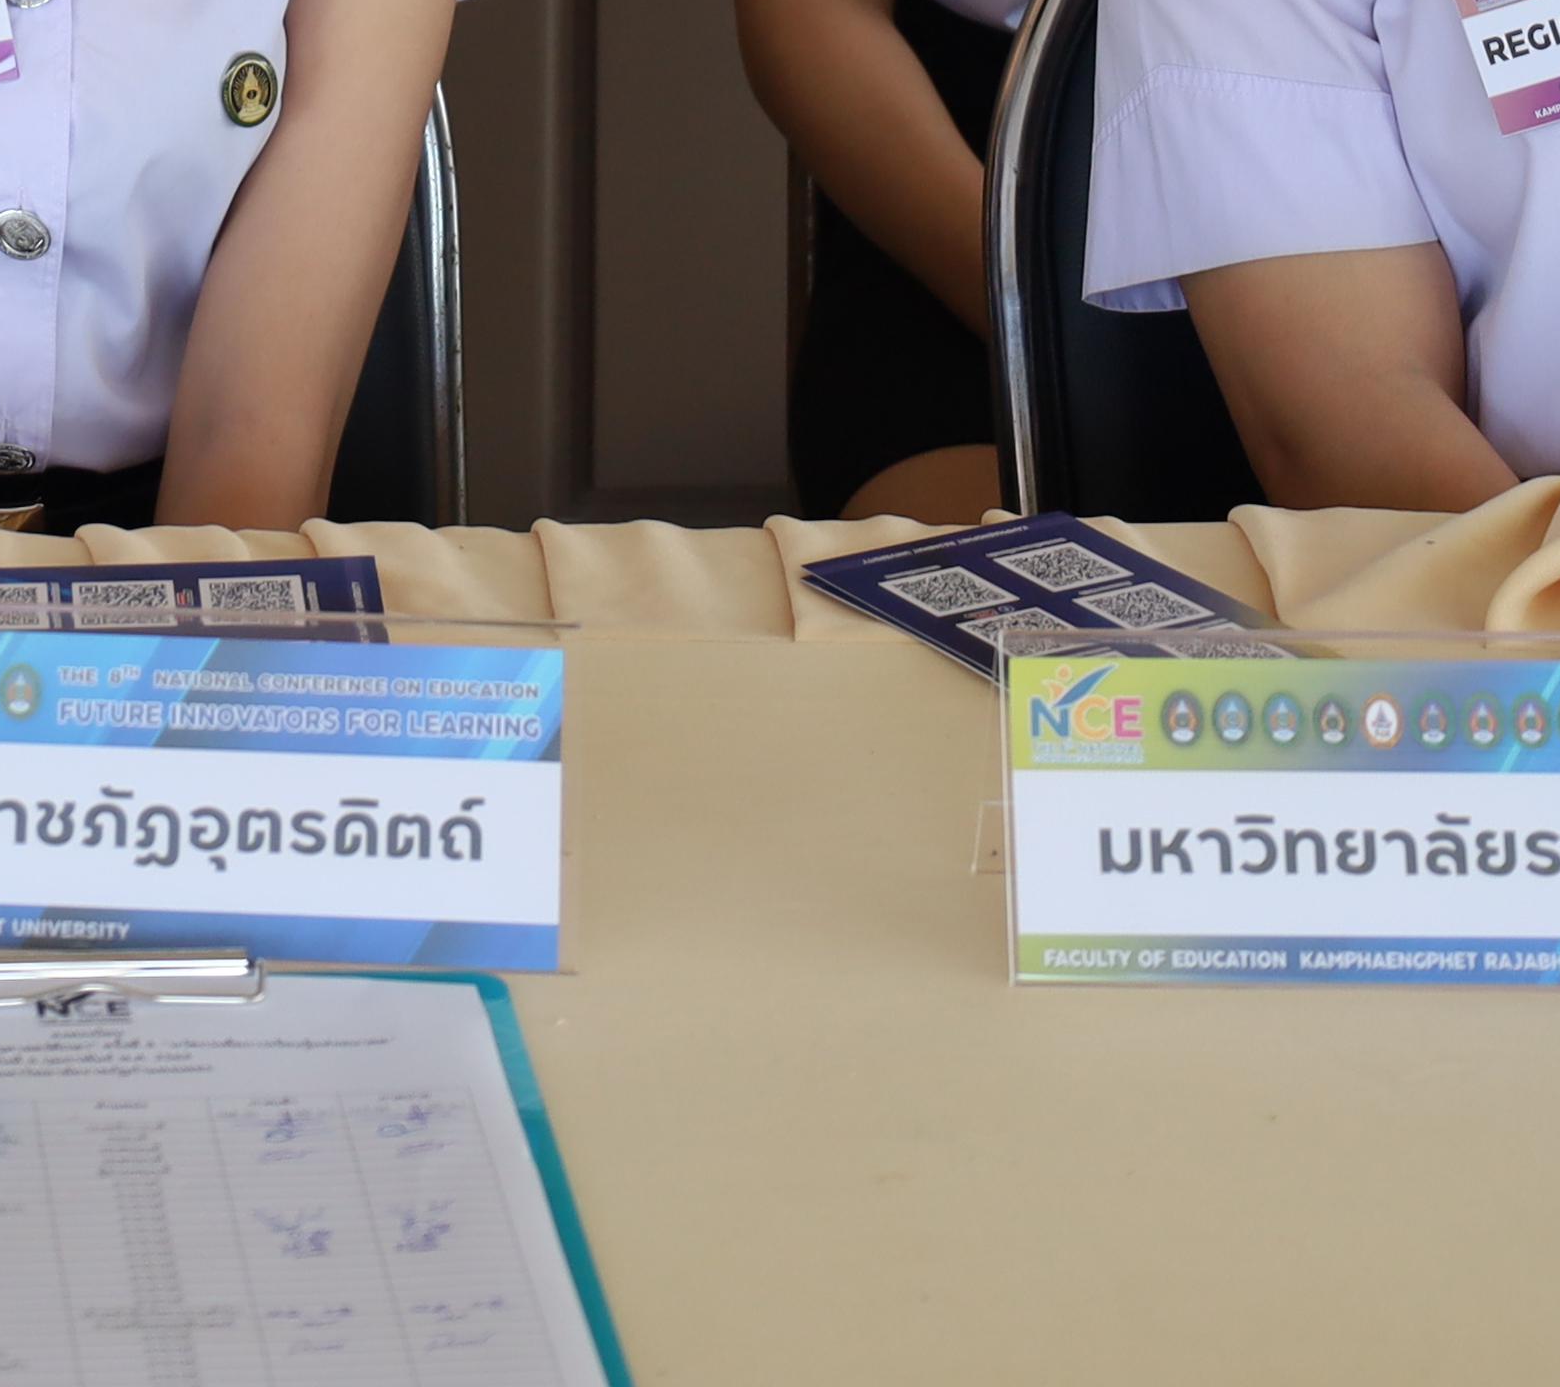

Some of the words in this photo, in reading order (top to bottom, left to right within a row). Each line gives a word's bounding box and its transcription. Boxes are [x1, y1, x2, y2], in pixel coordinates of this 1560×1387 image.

[58, 665, 98, 686] THE
[153, 668, 254, 692] NATIONAL
[257, 673, 387, 696] CONFERENCE
[393, 677, 421, 698] ON
[429, 679, 540, 701] EDUCATION
[58, 698, 162, 726] FUTURE
[171, 701, 340, 735] INNOVATORS
[346, 708, 400, 737] FOR
[407, 710, 541, 742] LEARNING
[1030, 695, 1144, 740] NCE
[12, 918, 130, 941] UNIVERSITY
[1043, 948, 1132, 968] FACULTY
[1137, 949, 1168, 969] OF
[1172, 949, 1287, 970] EDUCATION
[1300, 950, 1478, 971] KAMPHAENGPHET
